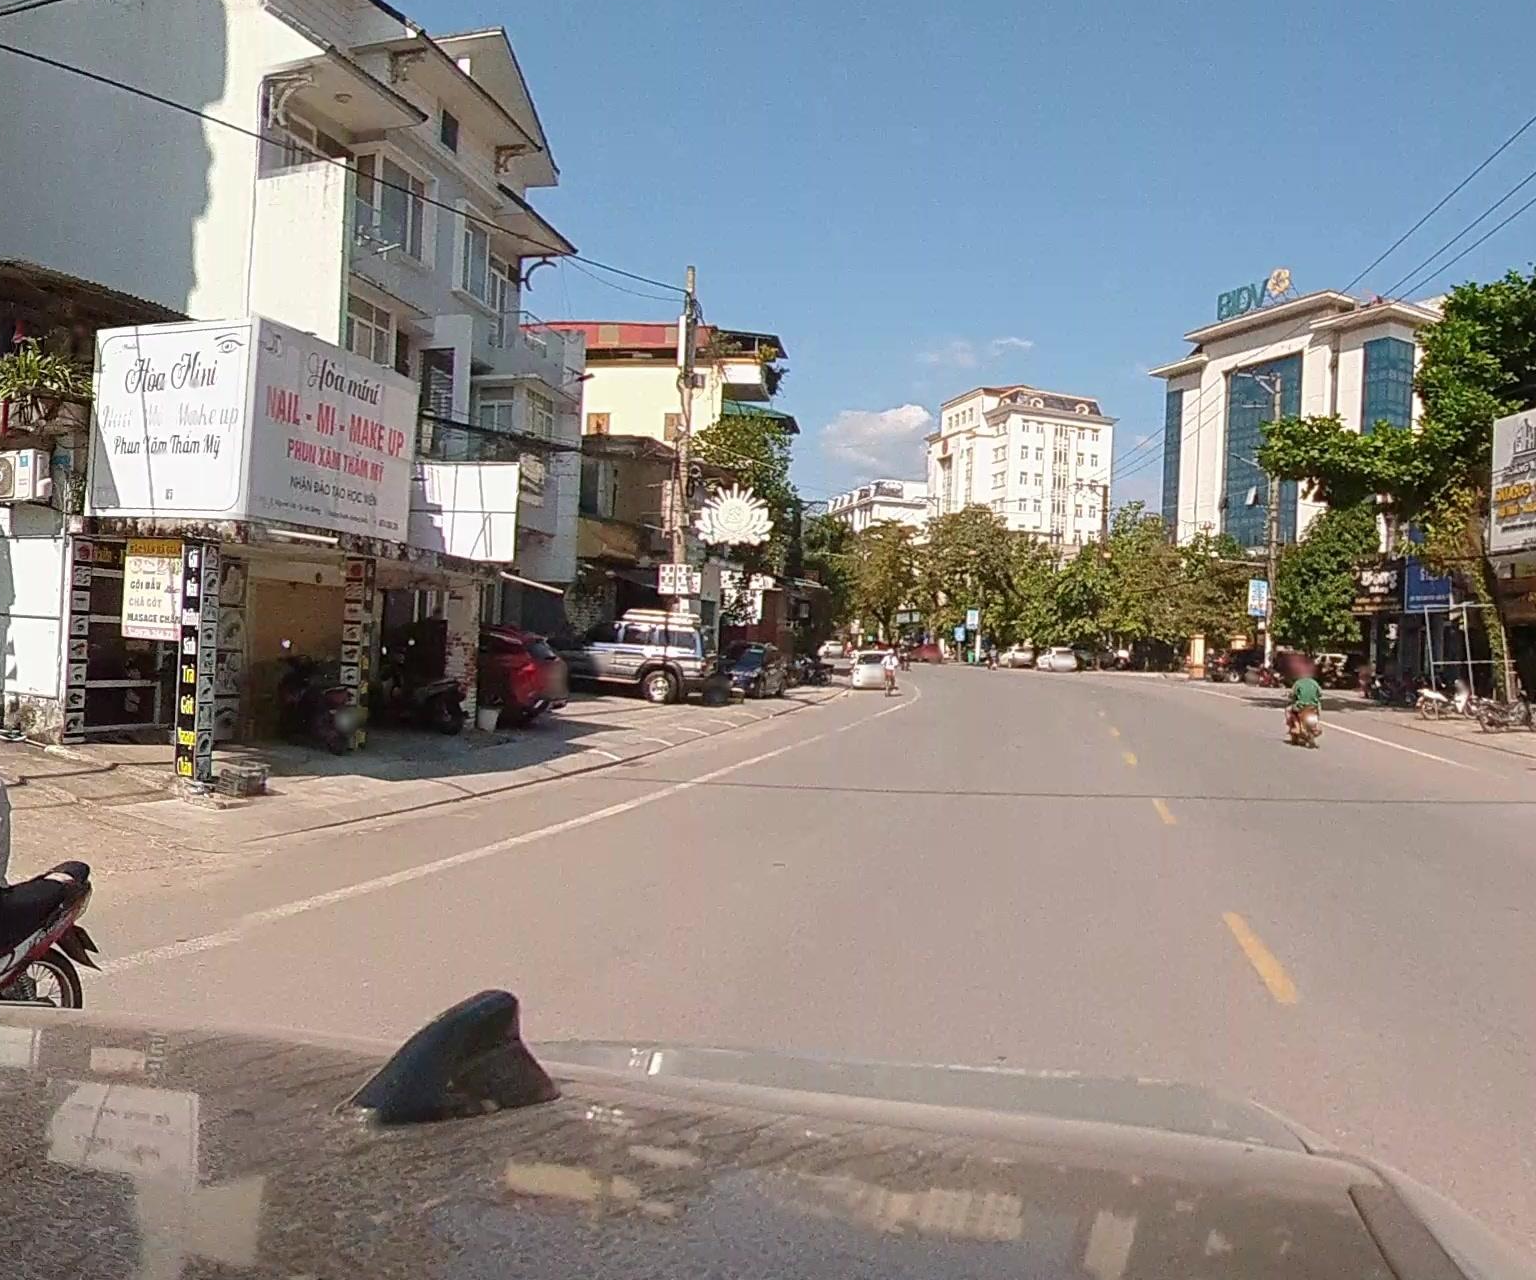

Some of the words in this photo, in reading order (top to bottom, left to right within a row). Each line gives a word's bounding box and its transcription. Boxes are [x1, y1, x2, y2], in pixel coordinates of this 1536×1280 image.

[1217, 278, 1270, 322] BIDV
[265, 384, 300, 426] NAIL
[317, 402, 336, 436] MI
[349, 413, 385, 450] MAKE
[387, 427, 405, 458] UP
[114, 435, 140, 455] Phun
[204, 433, 221, 460] Mỹ
[287, 438, 316, 466] PHUN
[127, 612, 158, 624] MASAGE
